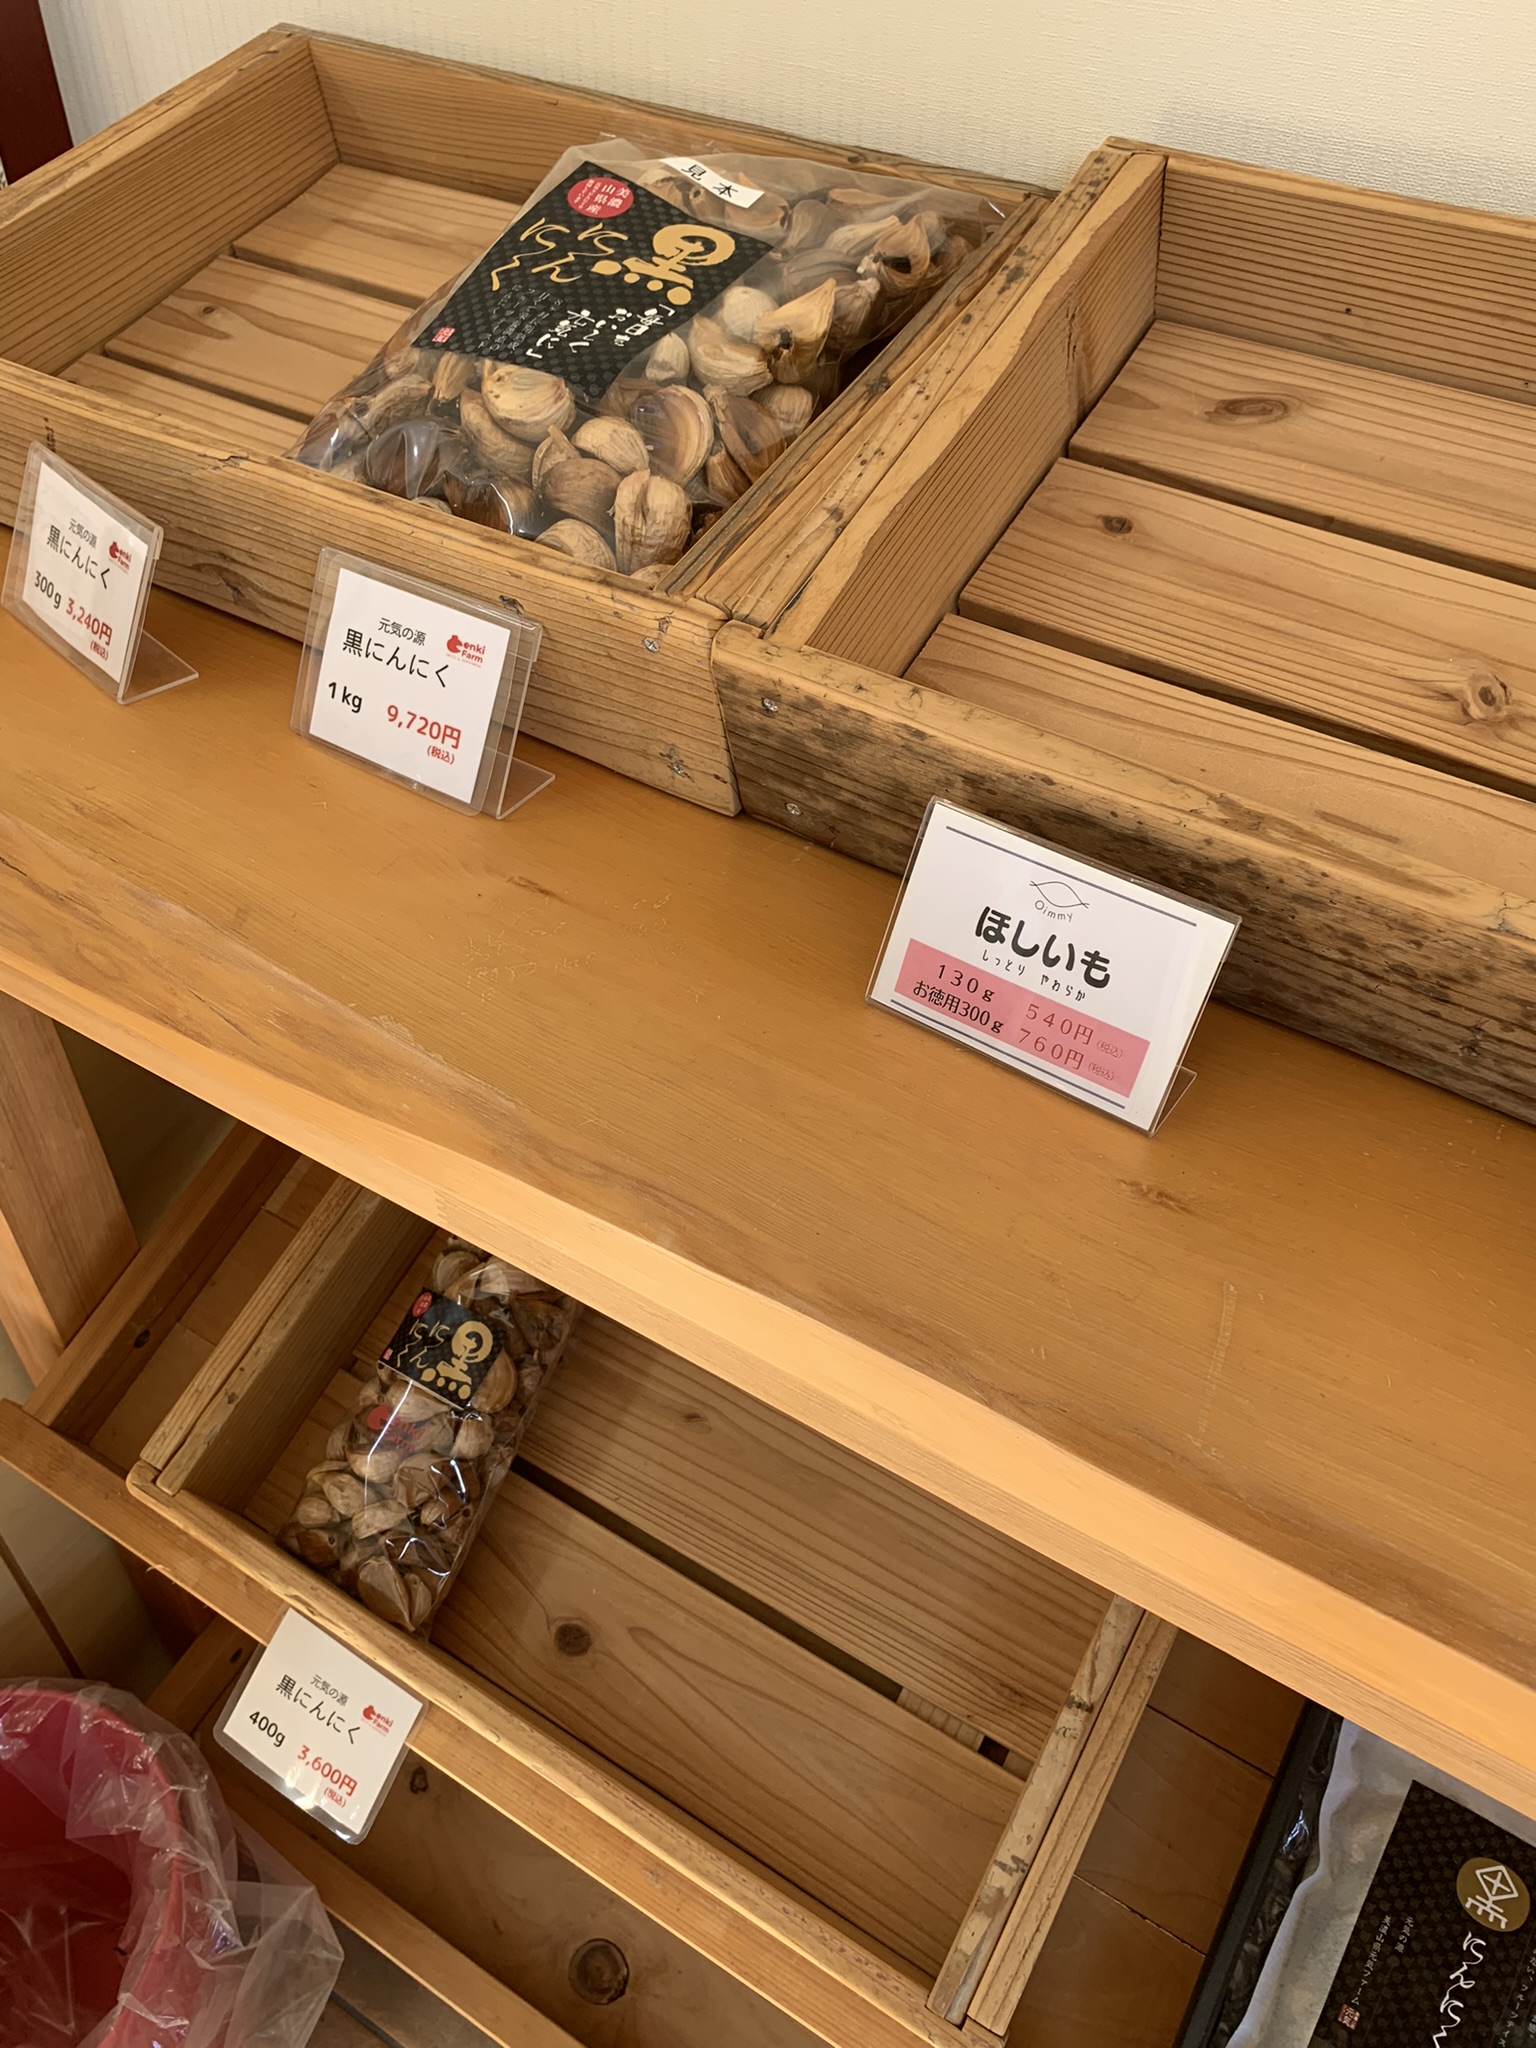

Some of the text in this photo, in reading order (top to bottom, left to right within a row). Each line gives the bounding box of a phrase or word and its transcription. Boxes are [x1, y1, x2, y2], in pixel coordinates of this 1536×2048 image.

[682, 164, 738, 198] 見本
[590, 224, 736, 306] 黒
[46, 524, 111, 590] 黒にんにく
[68, 518, 98, 549] 元気の源
[34, 570, 113, 646] 300g 3,240円
[378, 617, 427, 647] 元気の源
[90, 640, 110, 661] (税込)
[343, 627, 450, 688] 黒にんにく
[461, 650, 483, 664] Farm
[328, 681, 462, 750] 1kg 9,720円
[427, 745, 456, 766] (税込)
[974, 906, 1111, 989] ほしいも
[981, 949, 1086, 1002] しっとり やわらか
[912, 980, 1004, 1034] お徳用300g
[1017, 1028, 1085, 1071] 760円
[938, 963, 995, 1004] 130g
[1025, 1002, 1094, 1046] 540円
[420, 1320, 493, 1400] 黒
[275, 1674, 361, 1745] 黒にんにく
[310, 1674, 350, 1707] 元気の源
[249, 1711, 358, 1796] 400g 3,600円
